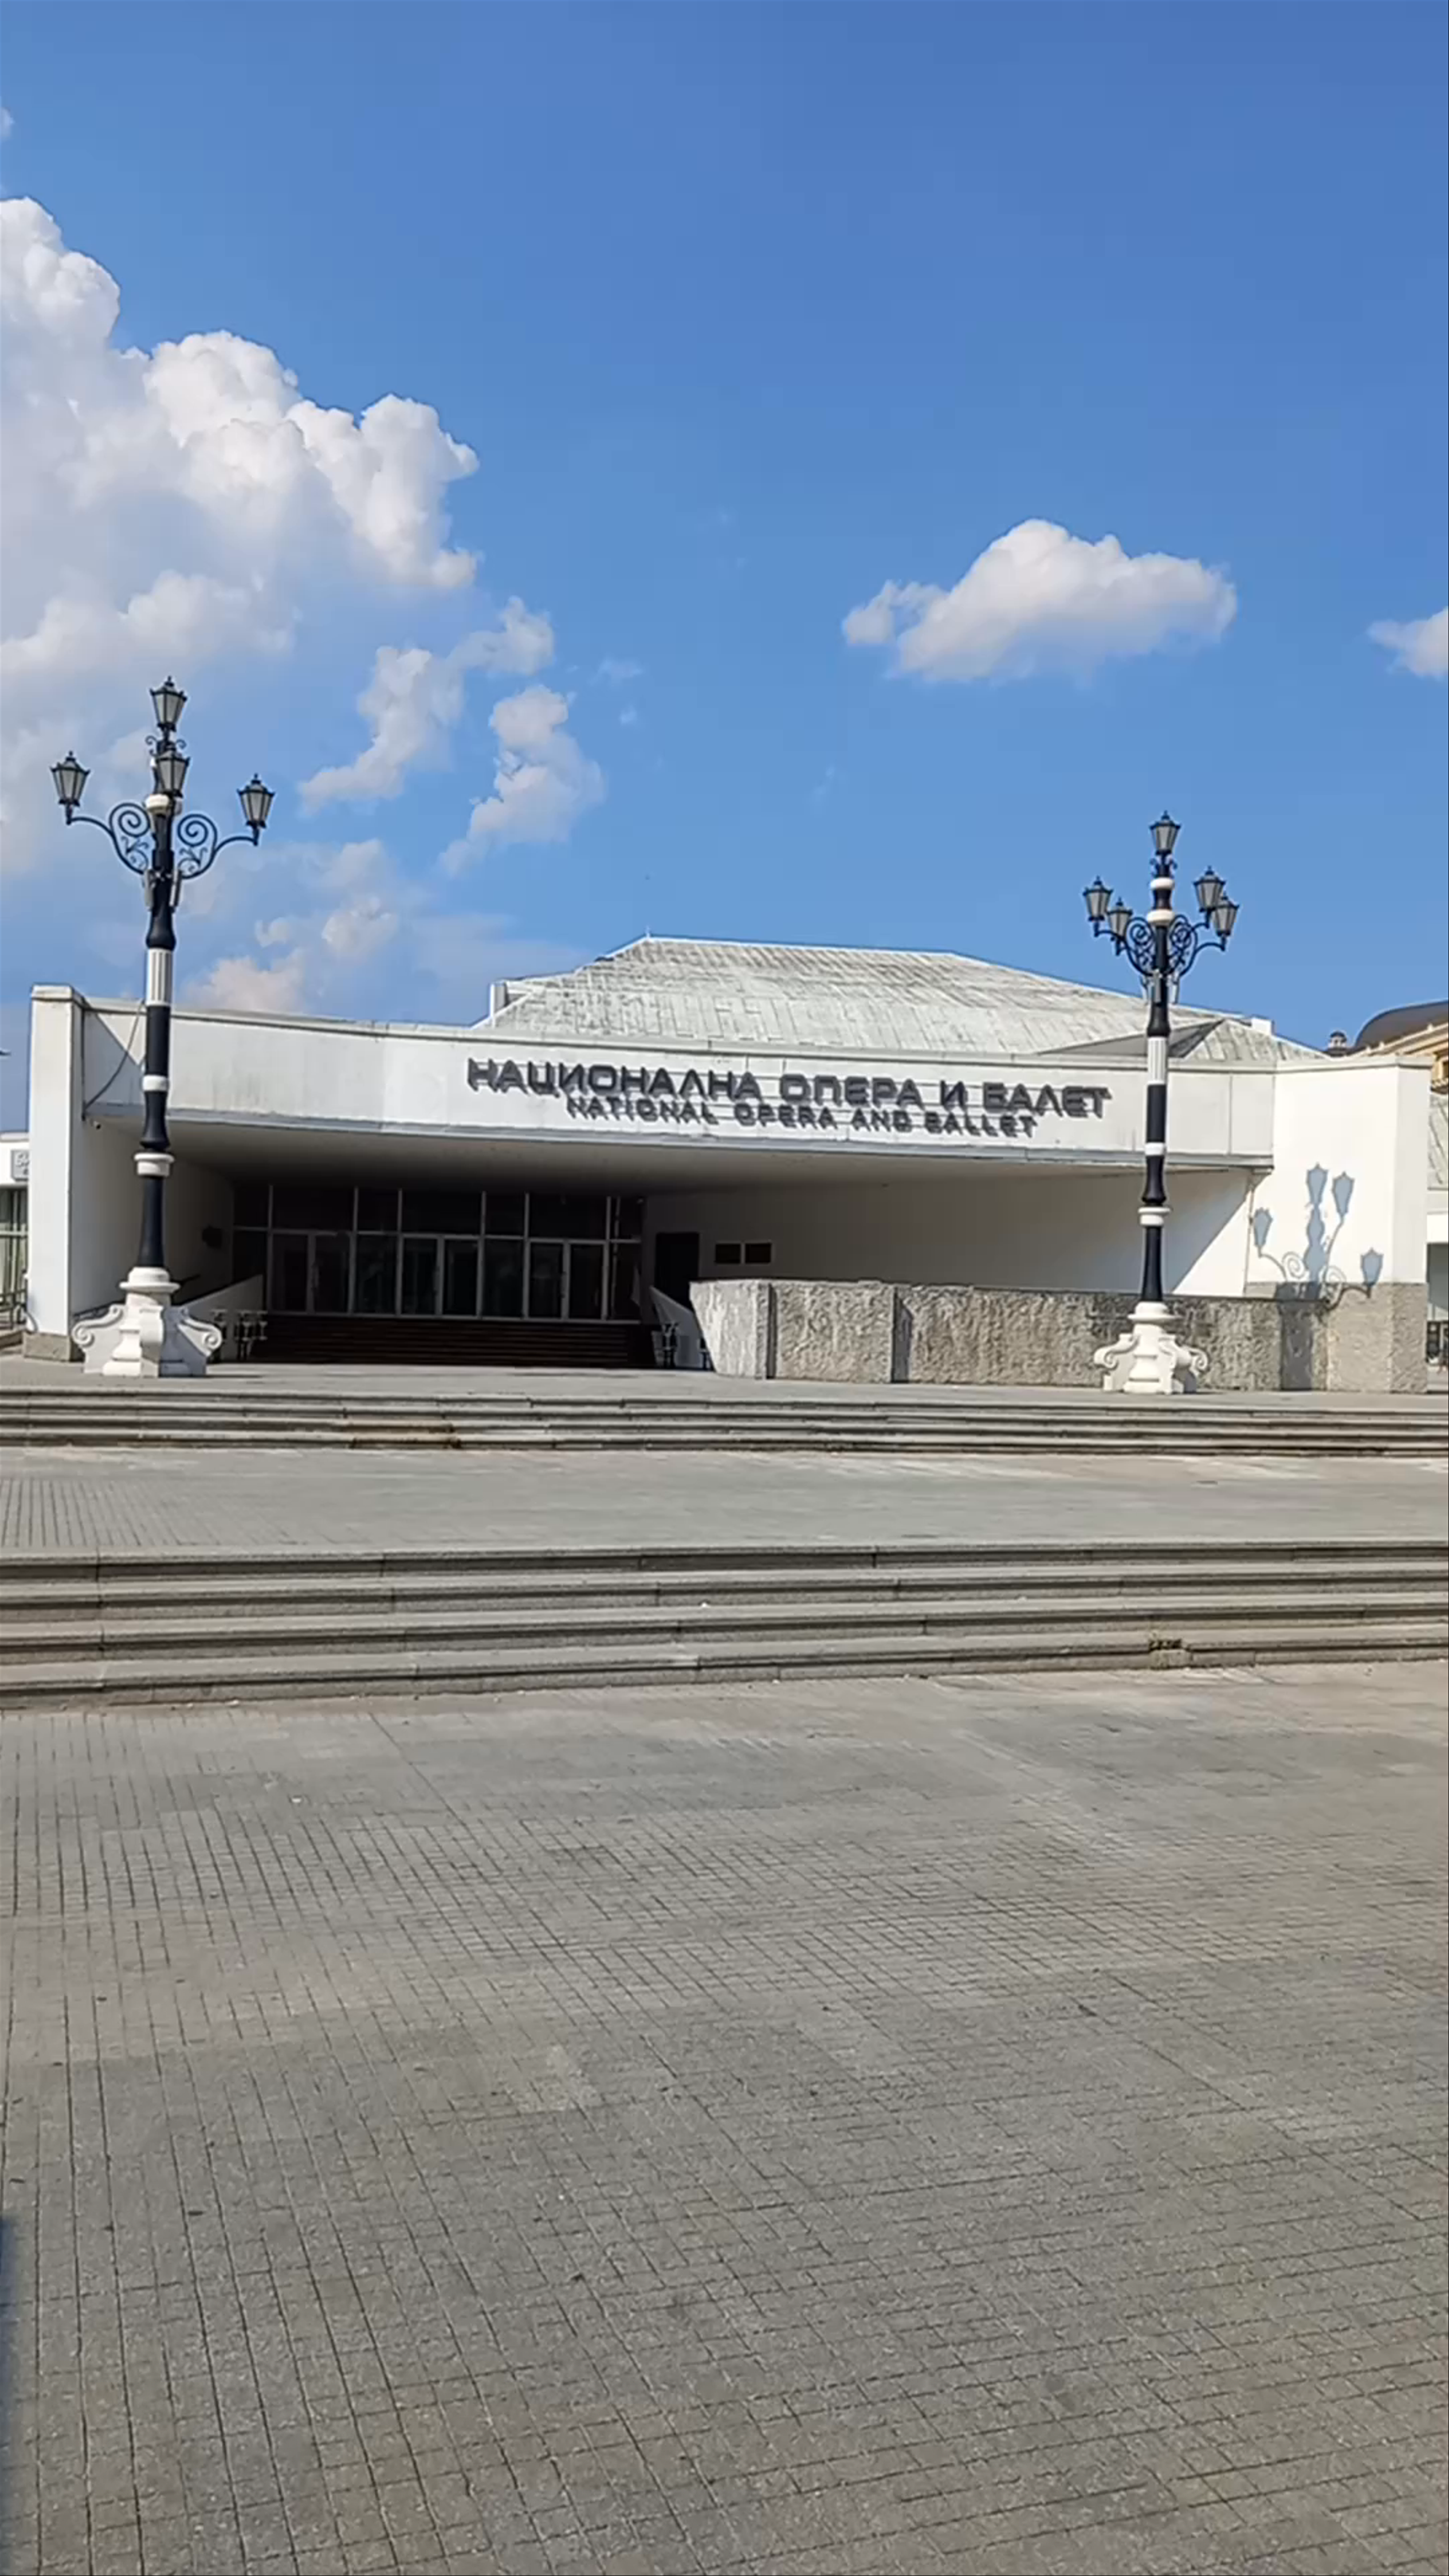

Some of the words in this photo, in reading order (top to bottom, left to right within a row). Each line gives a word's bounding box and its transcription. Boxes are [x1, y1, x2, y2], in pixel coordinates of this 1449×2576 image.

[468, 1058, 761, 1101] НАЦИОНАЛНА
[780, 1073, 924, 1110] ОПЕРА
[941, 1080, 968, 1110] И
[983, 1082, 1112, 1118] БАЛЕТ
[566, 1097, 718, 1125] NATIONAL
[734, 1103, 838, 1130] OPERA
[851, 1108, 912, 1132] AND
[924, 1111, 1038, 1137] BALLET
